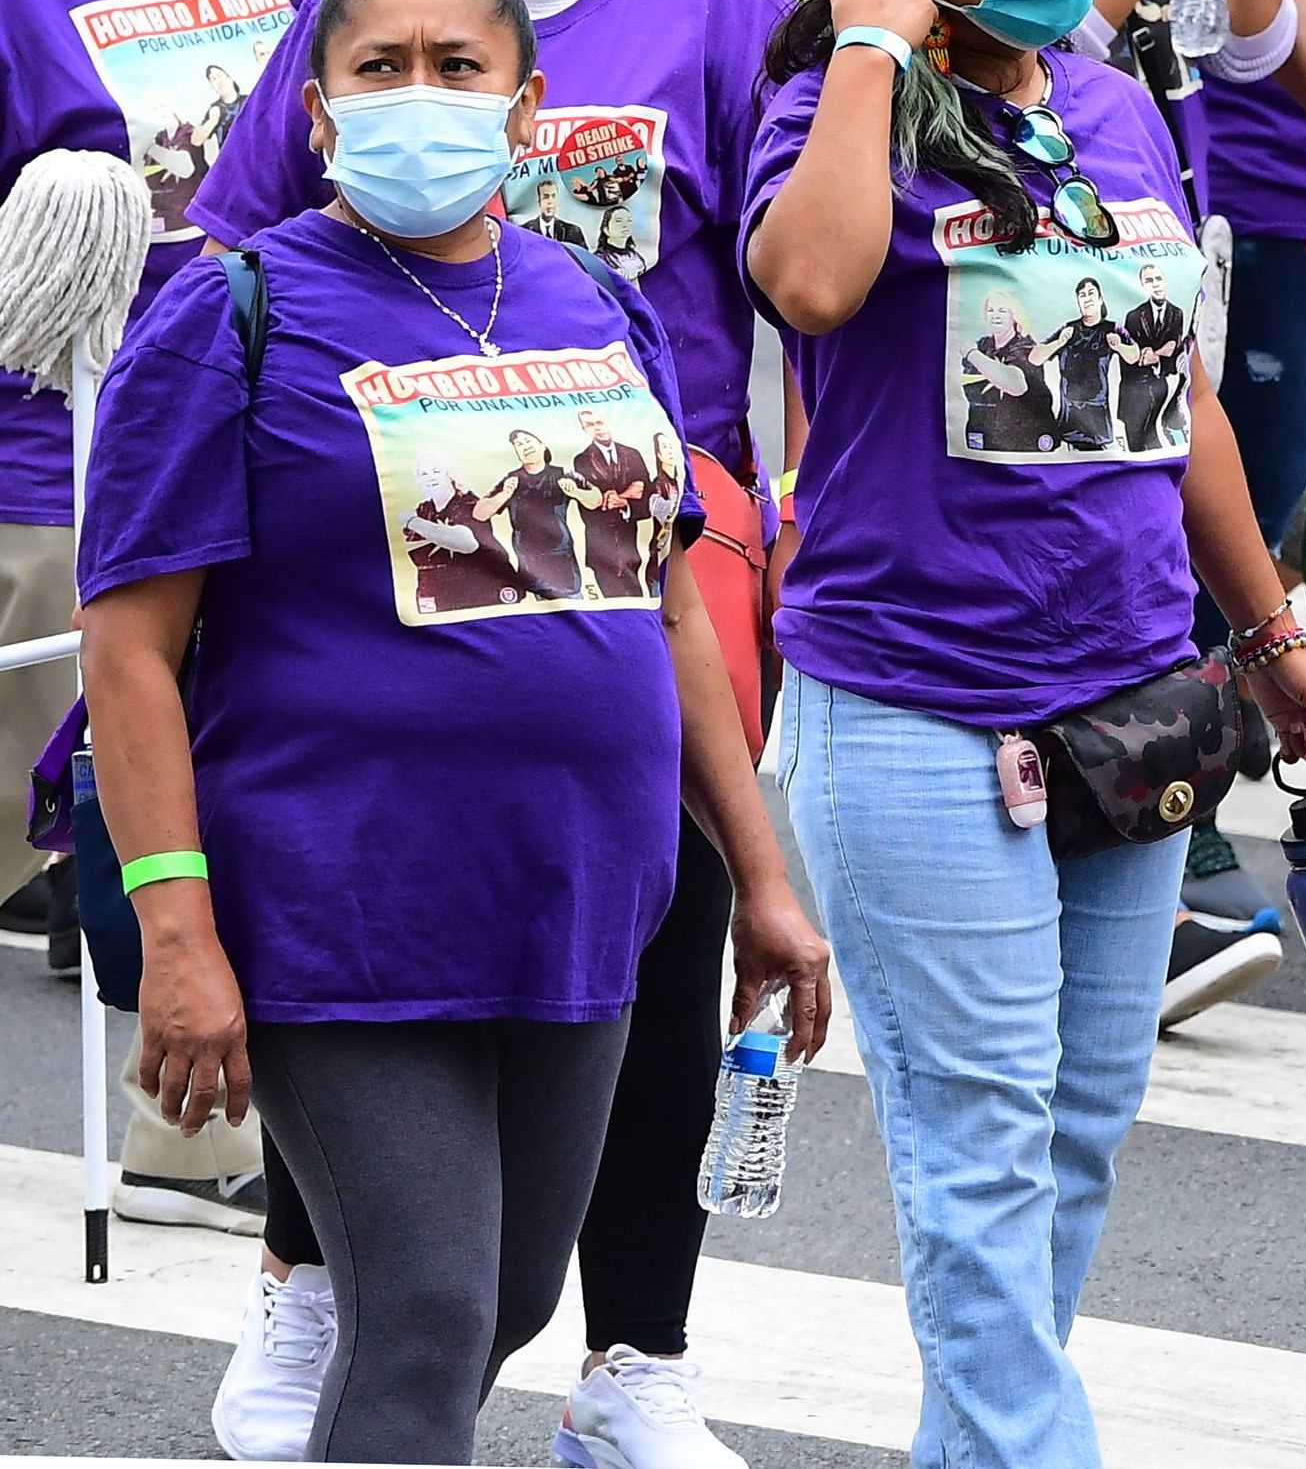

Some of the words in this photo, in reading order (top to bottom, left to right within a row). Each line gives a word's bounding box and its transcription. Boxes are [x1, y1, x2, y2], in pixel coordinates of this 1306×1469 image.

[90, 1, 195, 46] HOMBRO
[137, 36, 170, 55] POR
[173, 32, 206, 49] UNA
[207, 23, 246, 43] VIDA
[248, 9, 297, 34] MEJO
[566, 150, 587, 167] TO
[587, 134, 637, 160] STRIKE
[573, 123, 618, 149] READY
[360, 365, 500, 405] HOMBRO
[503, 366, 529, 393] A
[418, 396, 461, 414] POR
[466, 397, 513, 413] UNA
[515, 393, 565, 411] VIDA
[568, 383, 635, 407] MEJOR
